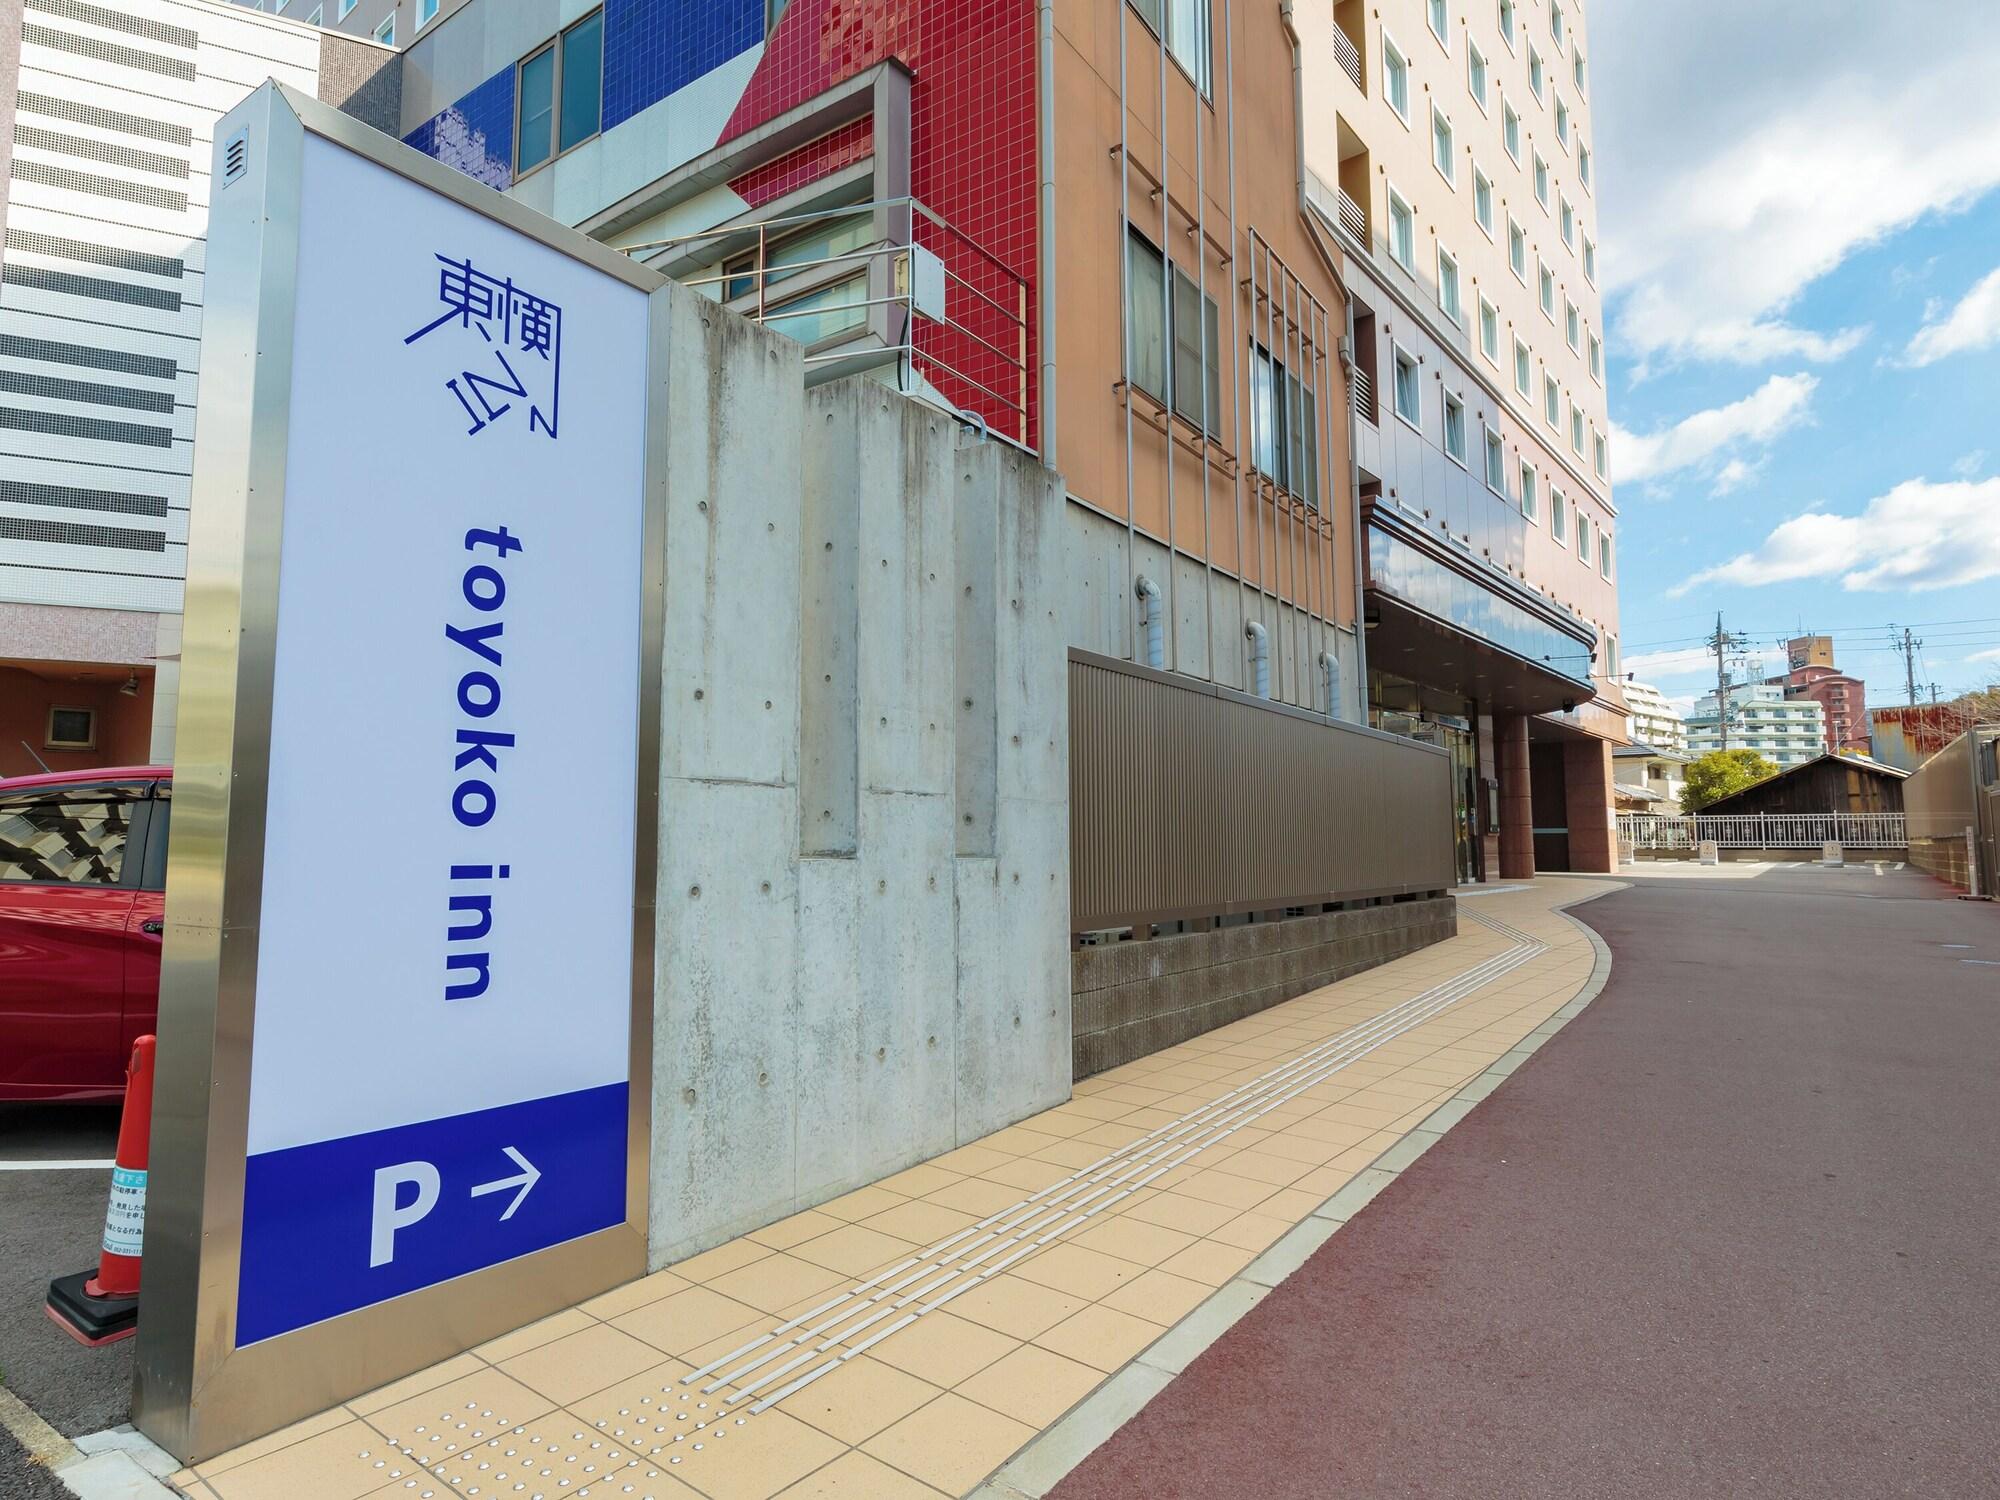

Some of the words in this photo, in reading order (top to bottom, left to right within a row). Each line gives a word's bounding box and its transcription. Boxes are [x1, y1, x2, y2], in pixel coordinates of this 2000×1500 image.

[445, 524, 523, 828] toyoko
[444, 864, 510, 1001] inn
[370, 1161, 440, 1268] P
